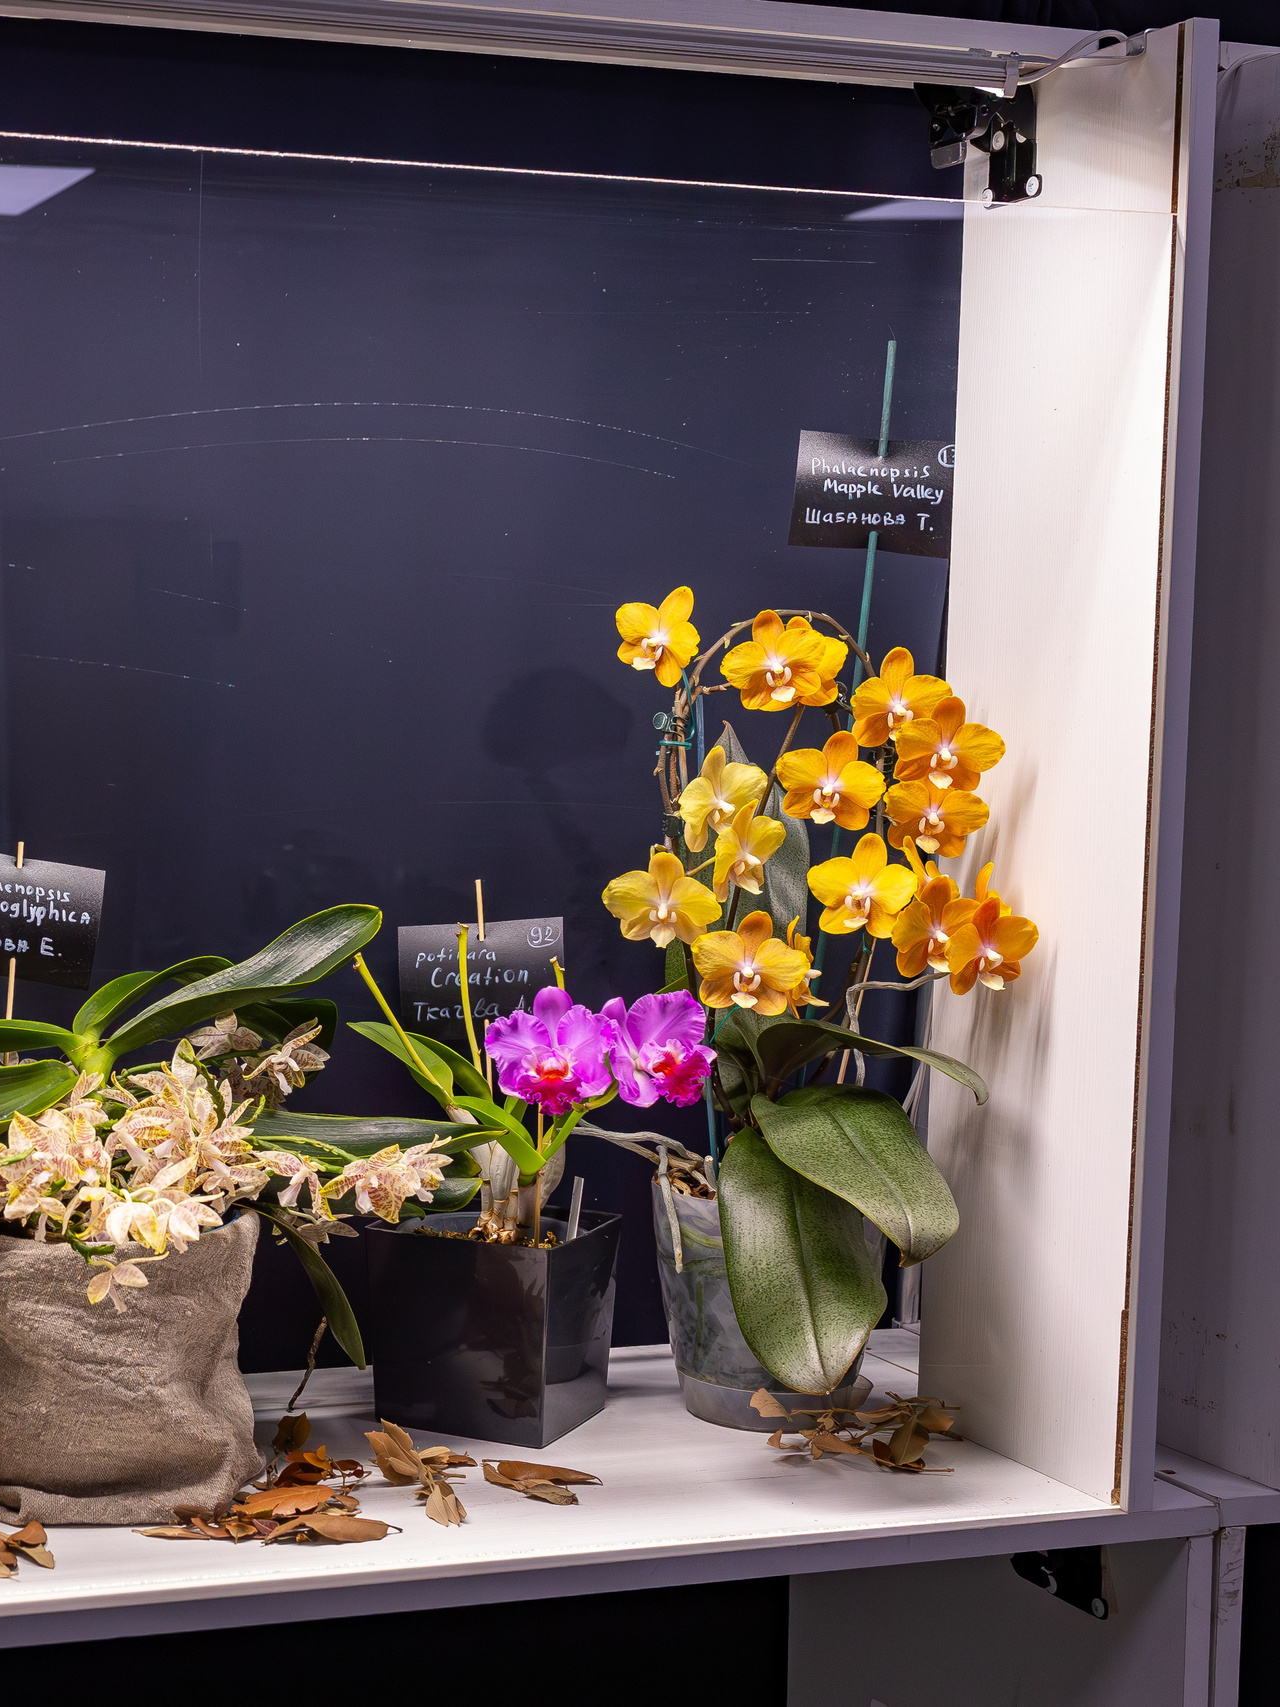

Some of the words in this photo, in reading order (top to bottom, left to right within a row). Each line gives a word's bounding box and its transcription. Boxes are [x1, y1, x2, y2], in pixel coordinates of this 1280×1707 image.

[943, 449, 955, 464] 1
[812, 458, 931, 484] Phalaenopsis
[823, 478, 883, 500] Mapple
[893, 484, 944, 505] Valley
[530, 926, 554, 944] 92
[416, 948, 497, 969] potiara
[431, 967, 528, 988] Creation
